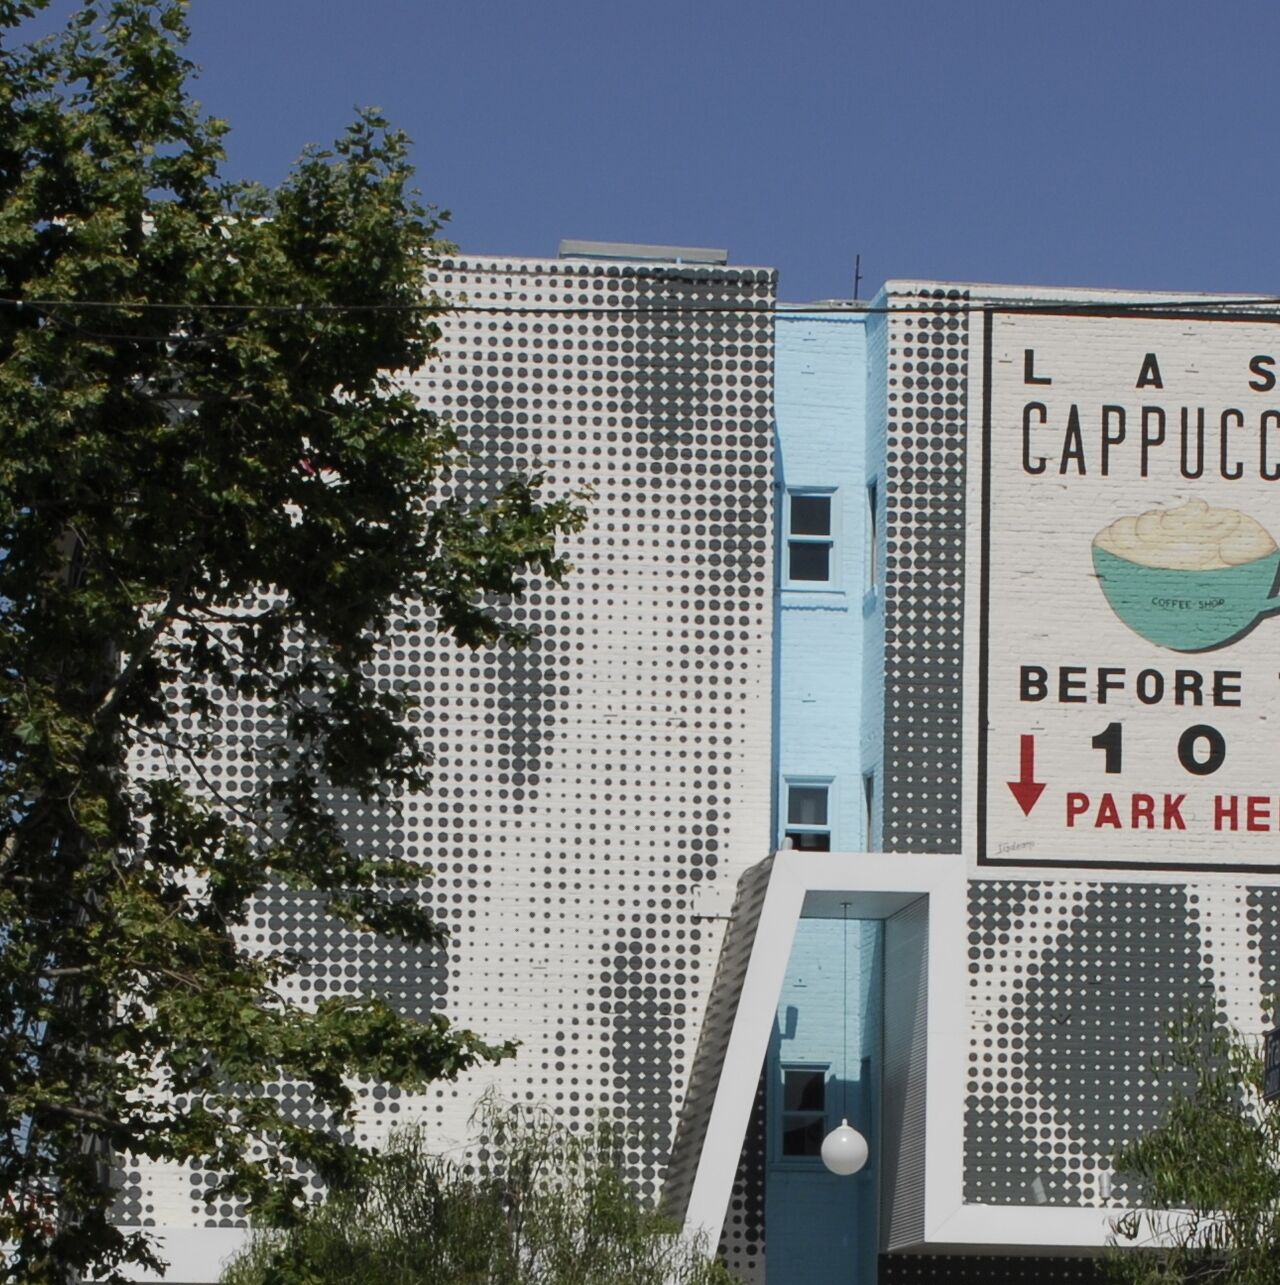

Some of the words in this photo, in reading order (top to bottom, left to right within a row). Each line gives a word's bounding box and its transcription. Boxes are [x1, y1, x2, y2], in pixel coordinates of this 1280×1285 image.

[1151, 597, 1192, 610] COFFEE
[1019, 665, 1242, 708] BEFORE
[1066, 792, 1188, 830] PARK
